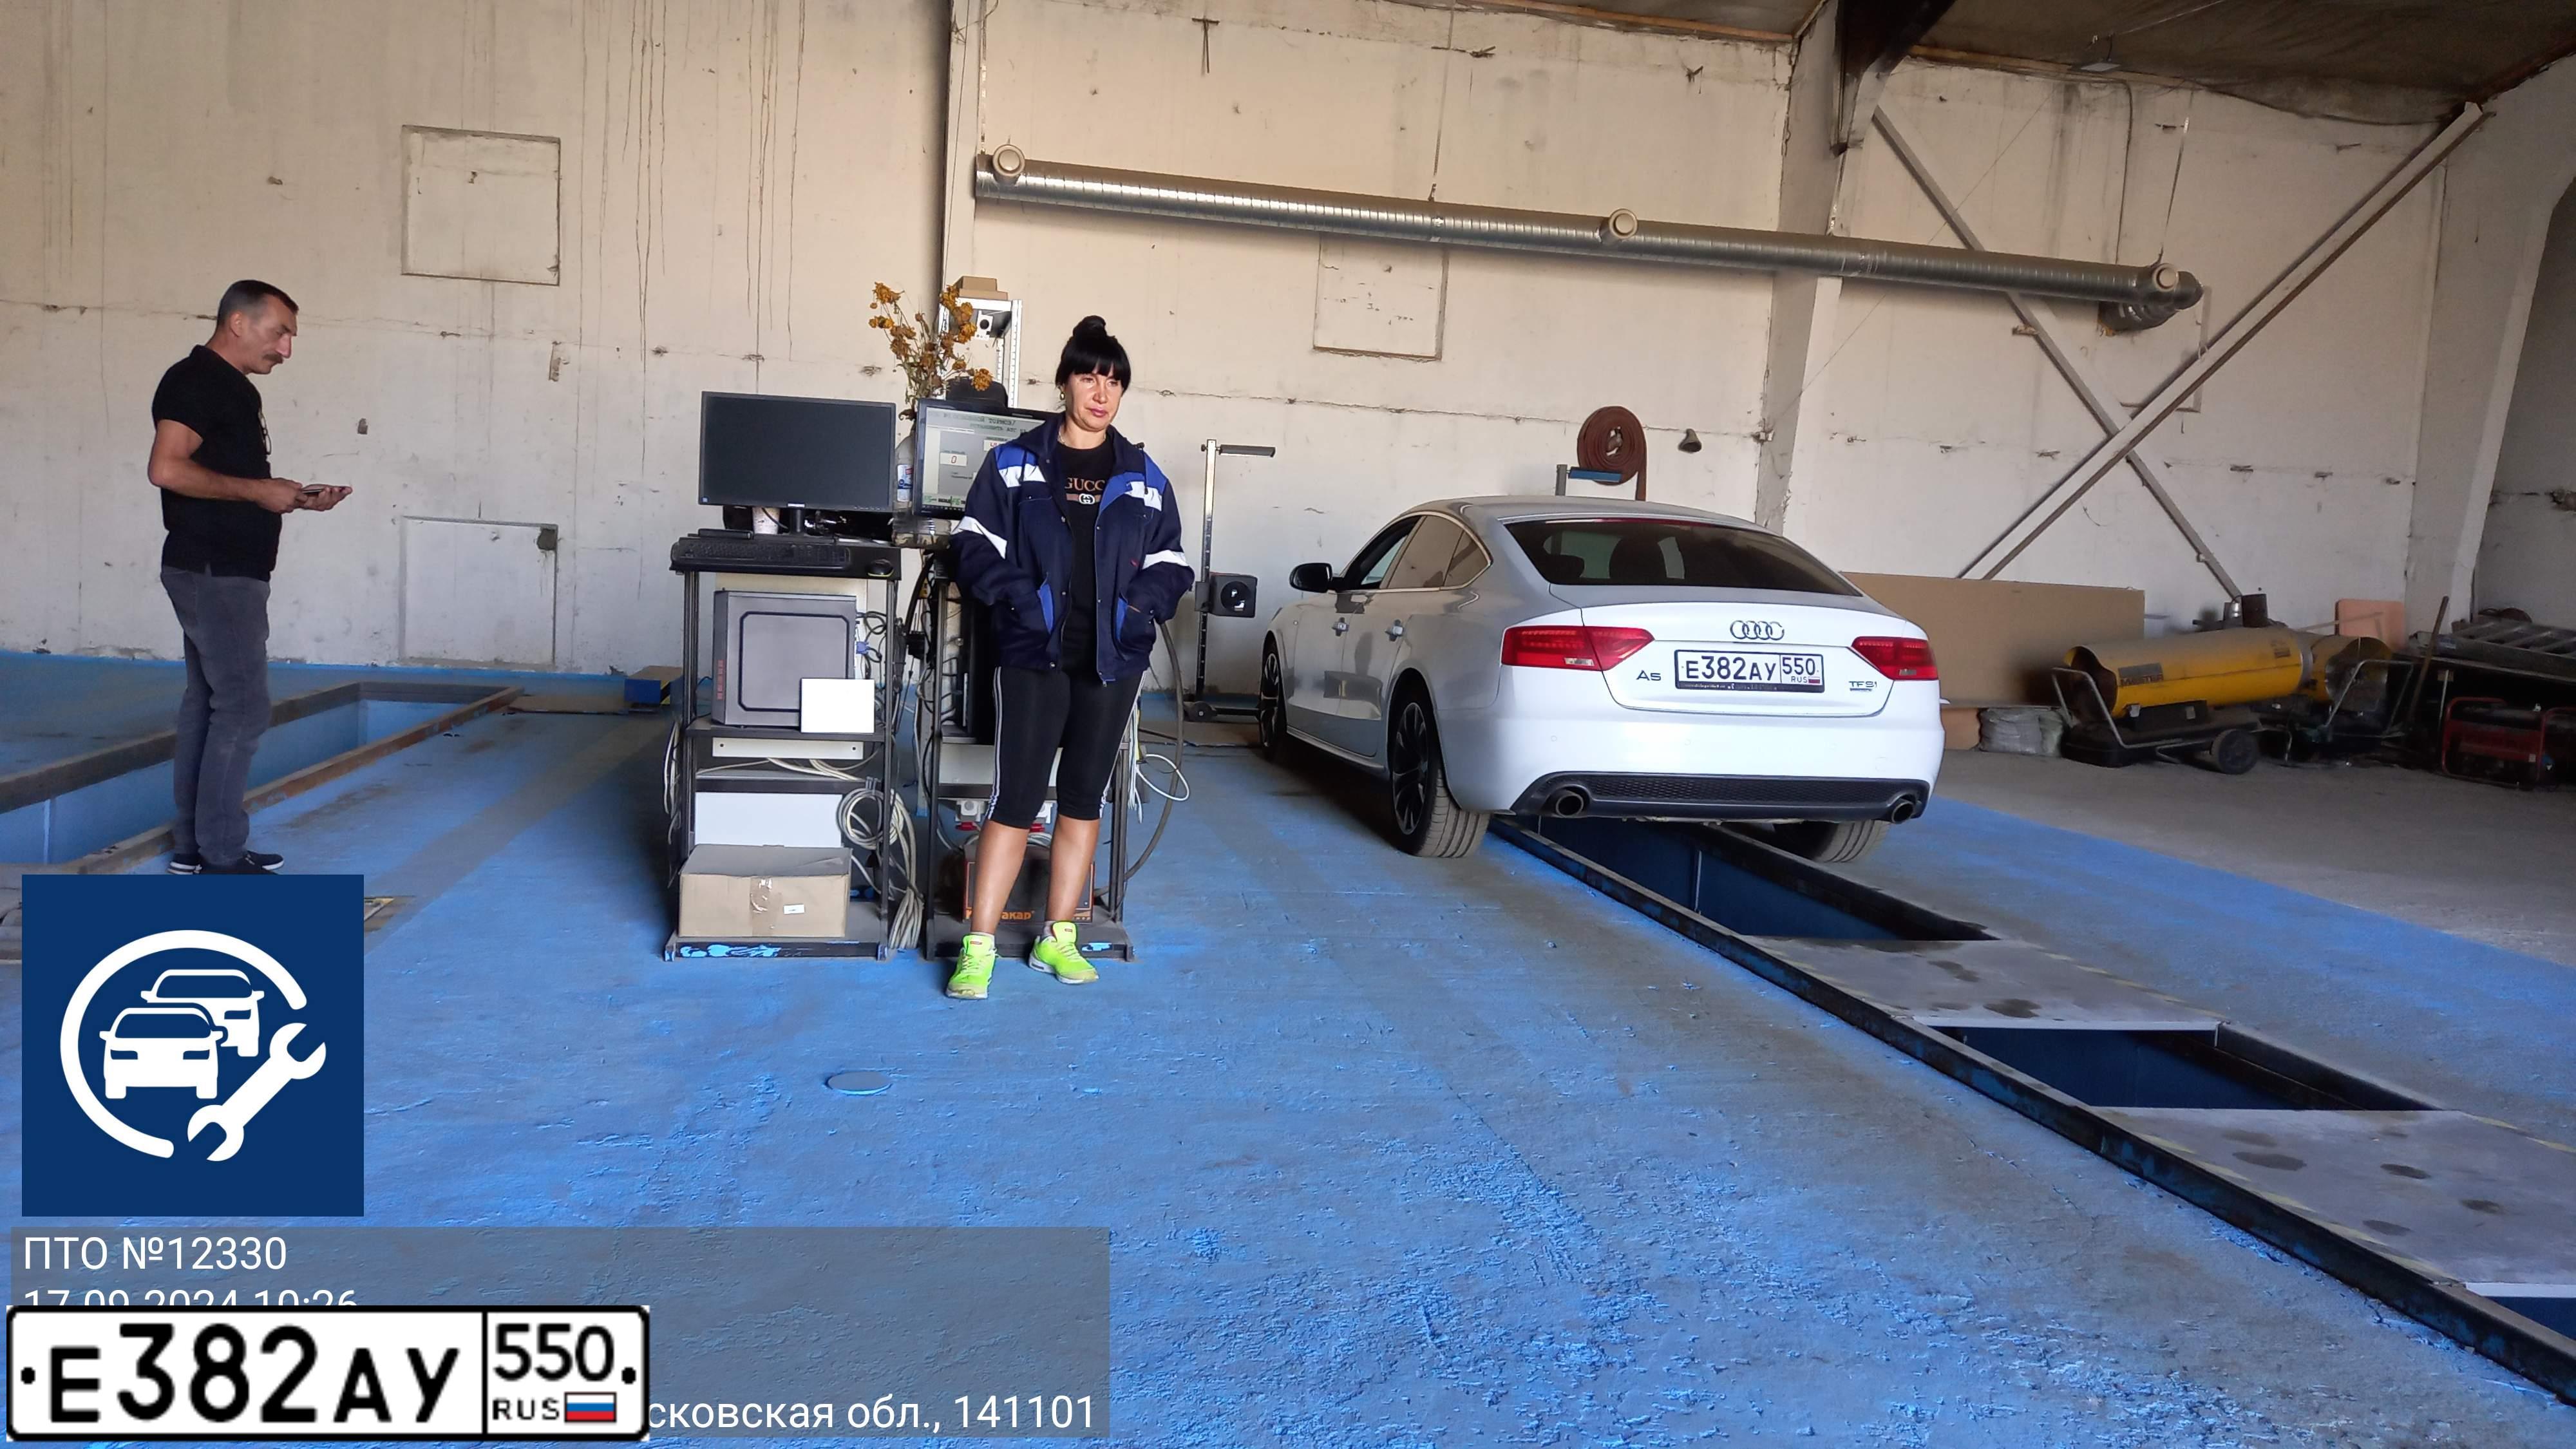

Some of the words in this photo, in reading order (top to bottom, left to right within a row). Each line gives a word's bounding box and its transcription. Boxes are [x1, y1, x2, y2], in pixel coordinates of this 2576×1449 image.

[1065, 477, 1105, 491] GUCC
[1636, 670, 1662, 681] A5
[1686, 656, 1776, 681] Е382АУ
[1782, 656, 1816, 676] 550
